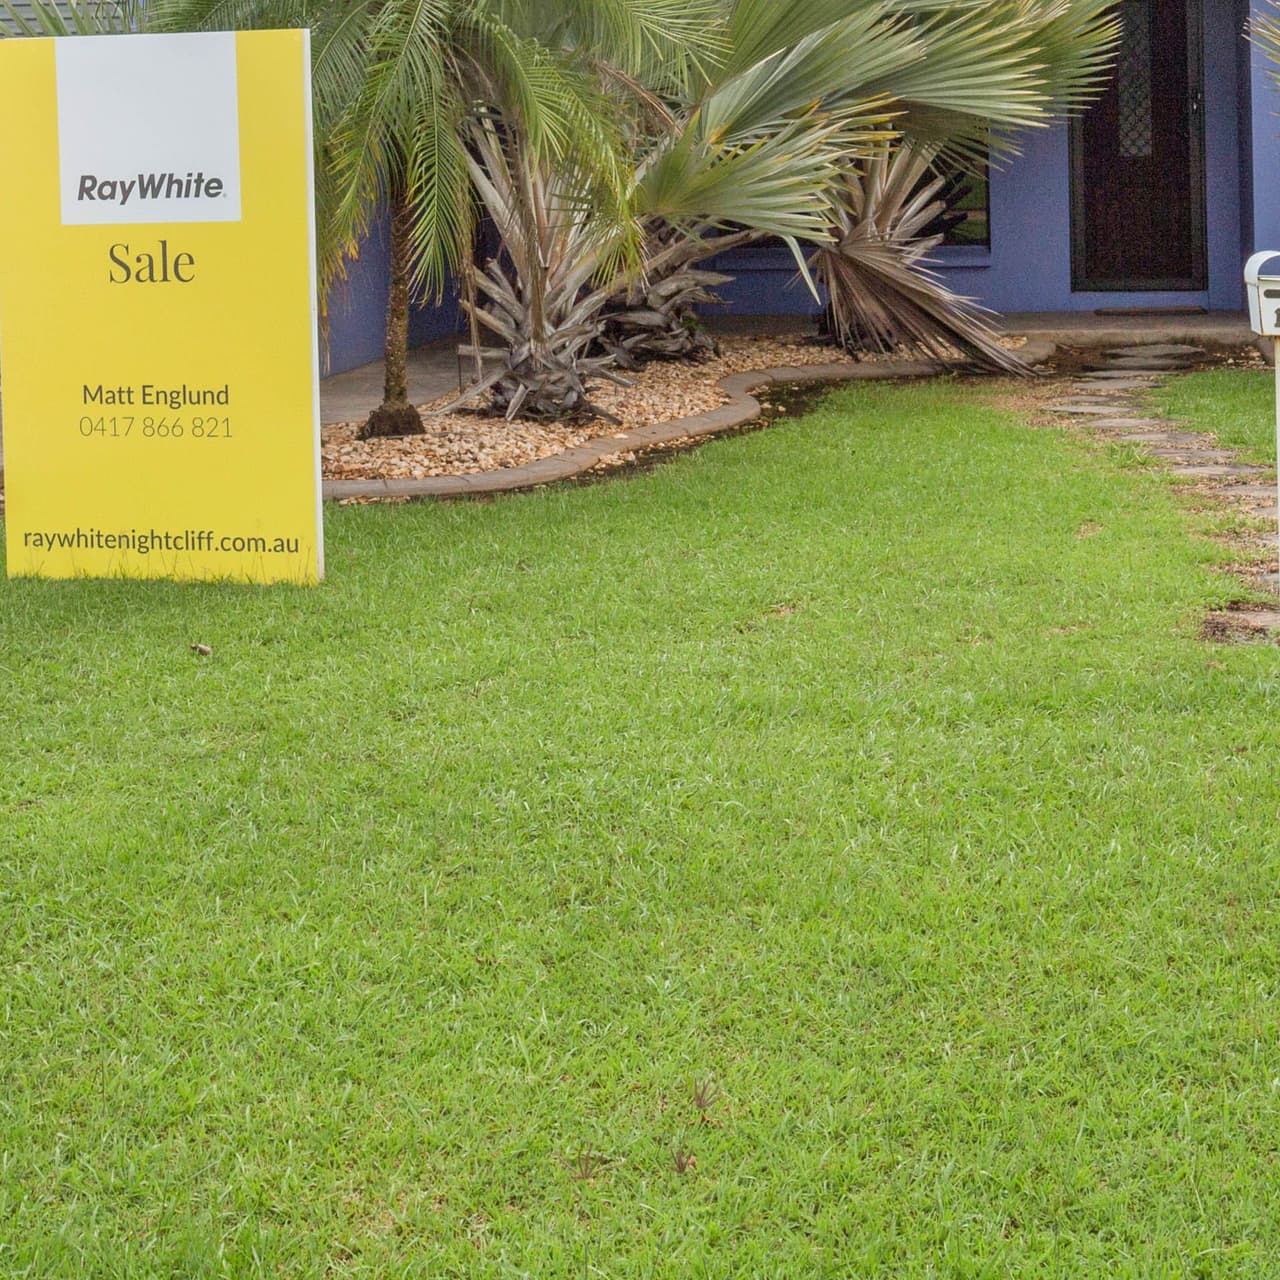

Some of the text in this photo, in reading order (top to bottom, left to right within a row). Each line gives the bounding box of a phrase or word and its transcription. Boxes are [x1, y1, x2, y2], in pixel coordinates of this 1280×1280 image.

[109, 239, 196, 284] Sale
[83, 384, 230, 410] Matt Englund
[79, 416, 233, 438] 0417 866 821
[23, 528, 299, 554] raywhitenightcliff.com.au
